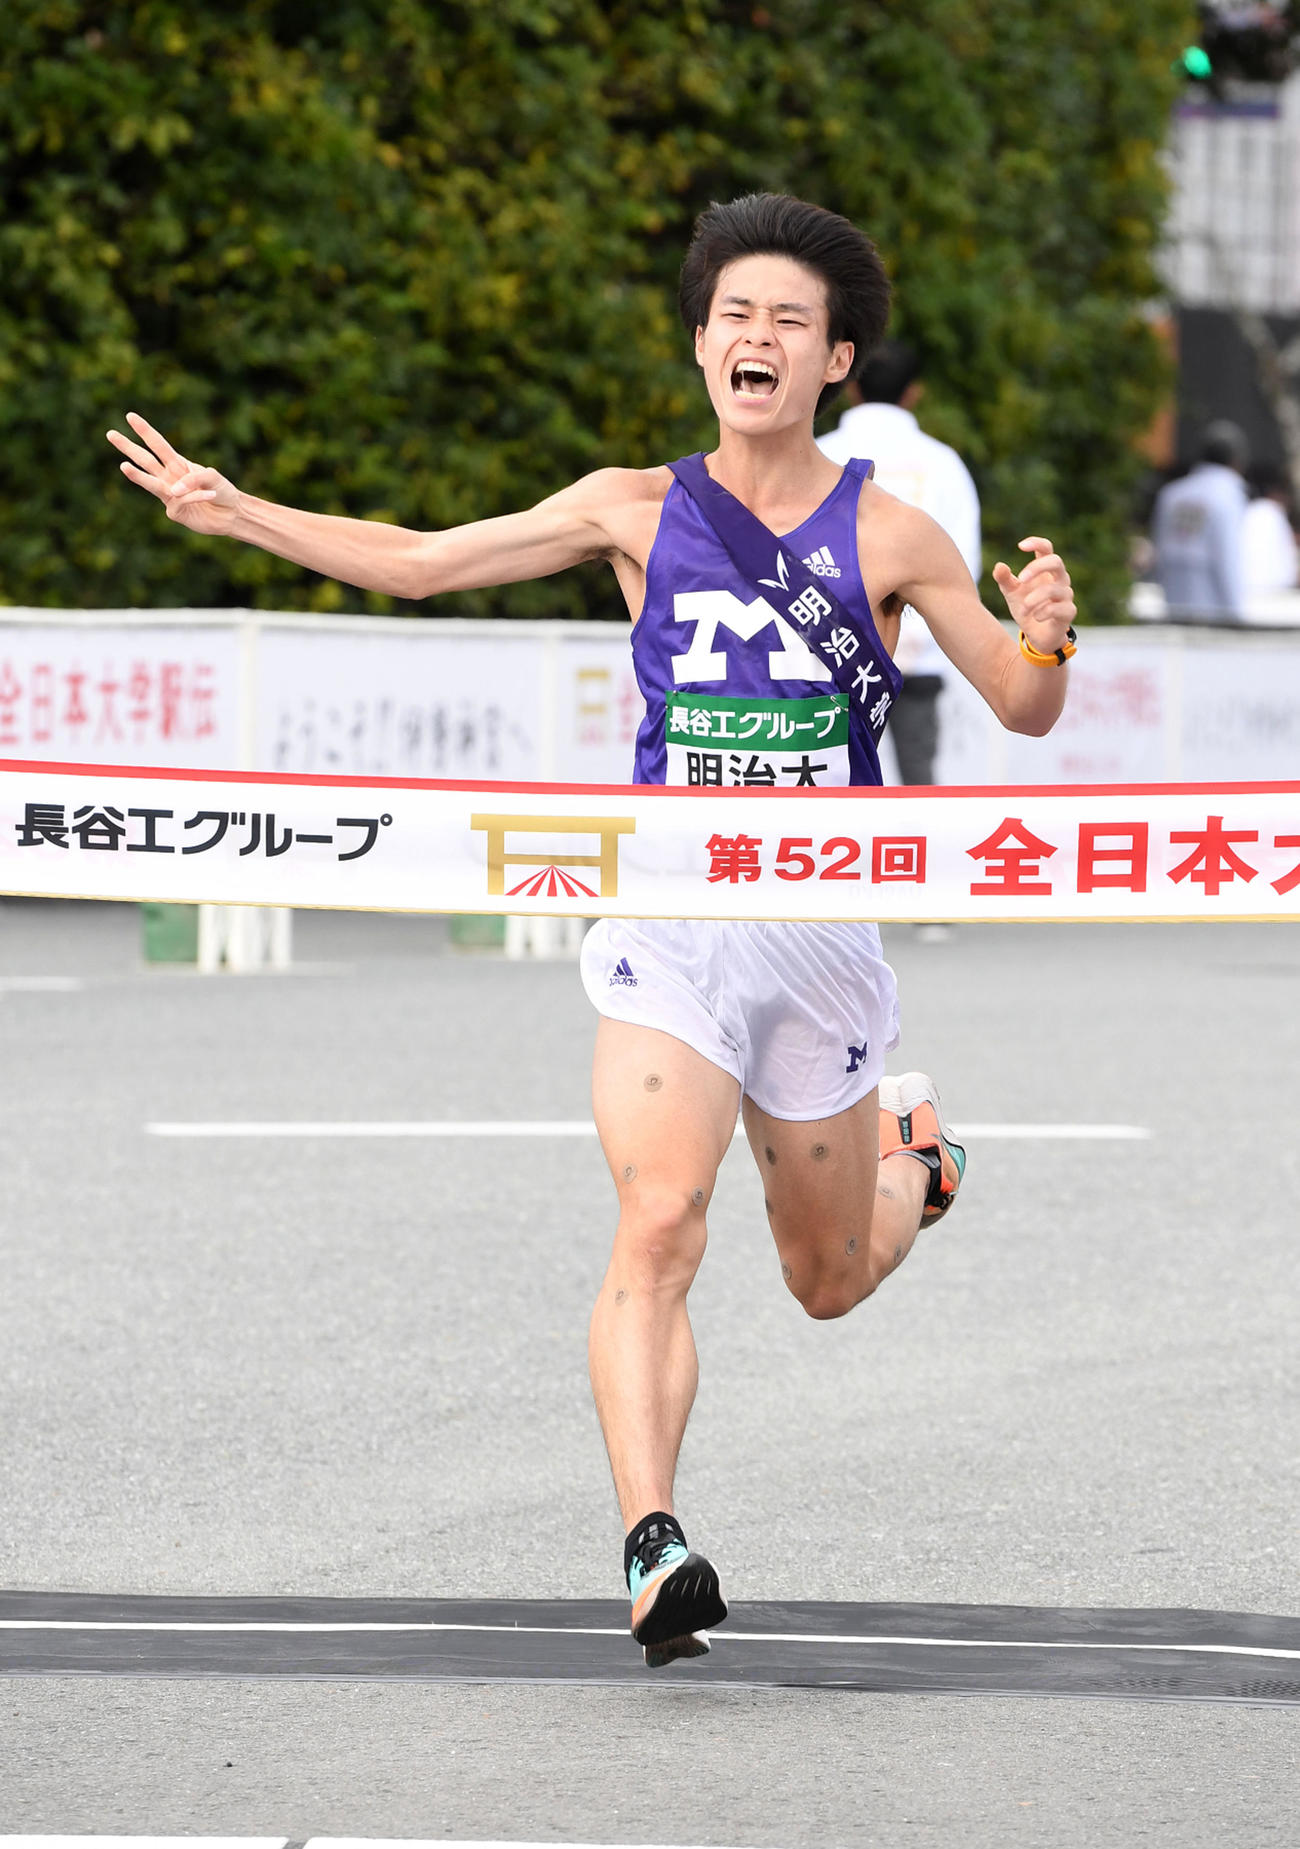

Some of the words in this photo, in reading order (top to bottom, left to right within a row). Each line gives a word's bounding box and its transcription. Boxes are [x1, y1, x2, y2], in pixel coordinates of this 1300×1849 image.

[806, 562, 842, 578] didas
[670, 590, 833, 685] M
[787, 585, 893, 730] 明治大学
[669, 705, 842, 740] 長谷工グループ
[686, 751, 828, 787] 明治大
[15, 802, 393, 862] 長谷工グループ
[704, 832, 927, 884] 第52回
[846, 1041, 867, 1073] M
